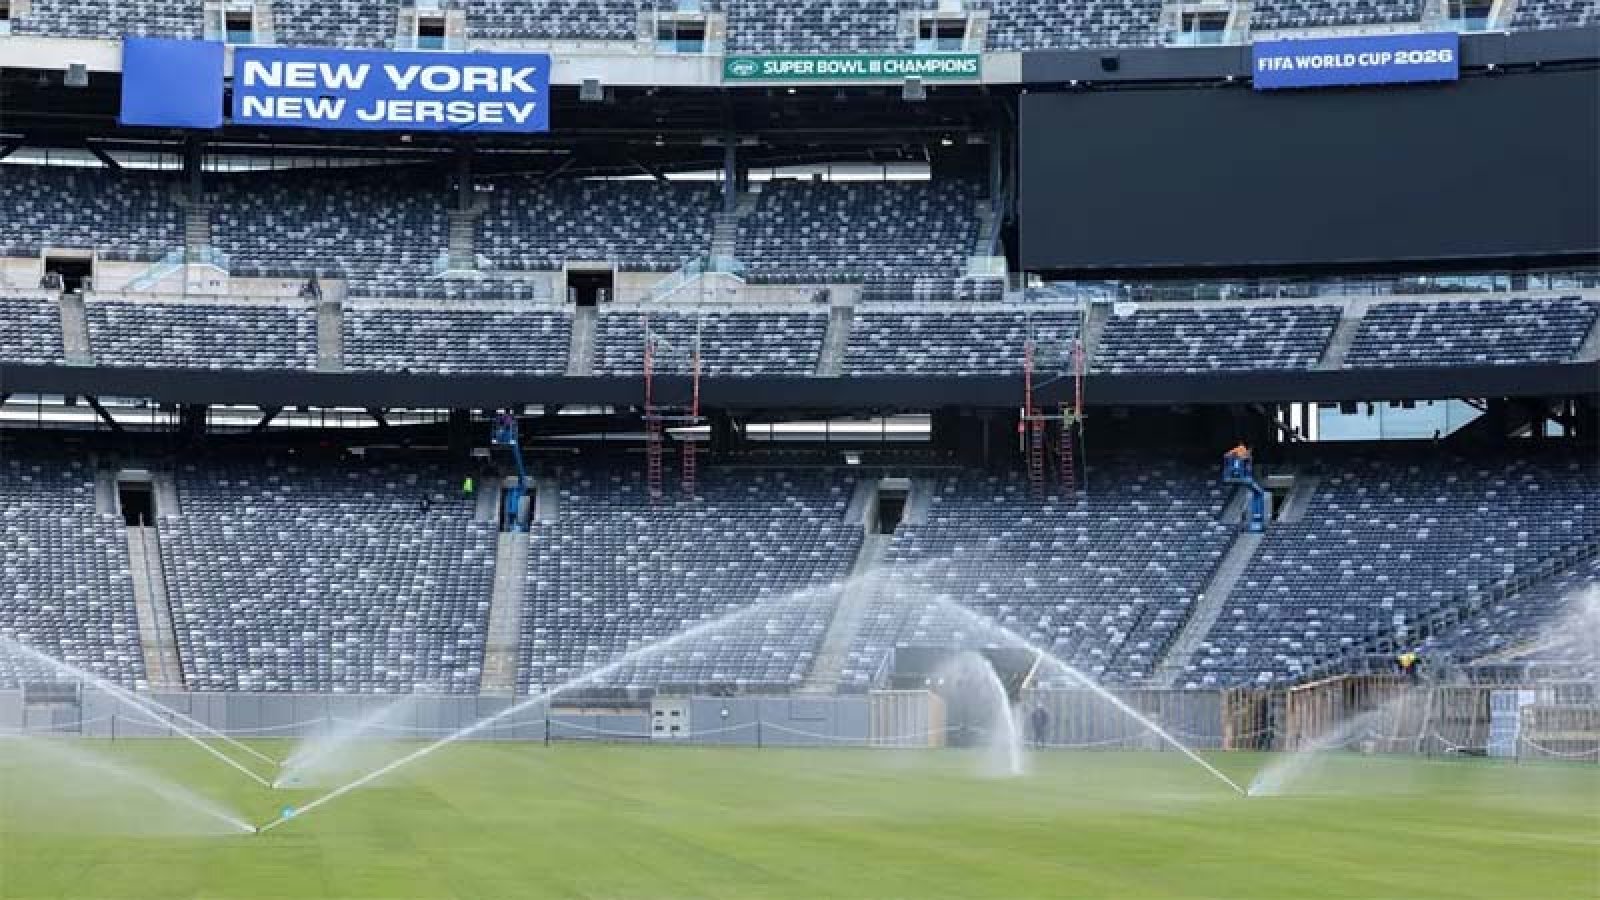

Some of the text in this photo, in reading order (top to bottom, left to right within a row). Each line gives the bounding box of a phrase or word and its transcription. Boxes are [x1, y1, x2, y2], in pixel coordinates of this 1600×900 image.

[763, 60, 814, 73] SUPER
[817, 60, 866, 74] BOWL
[883, 58, 977, 73] CHAMPIONS
[1258, 48, 1454, 71] FIFA WORLD CUP 2026
[244, 61, 536, 92] NEW YORK
[242, 96, 535, 124] NEW JERSEY
